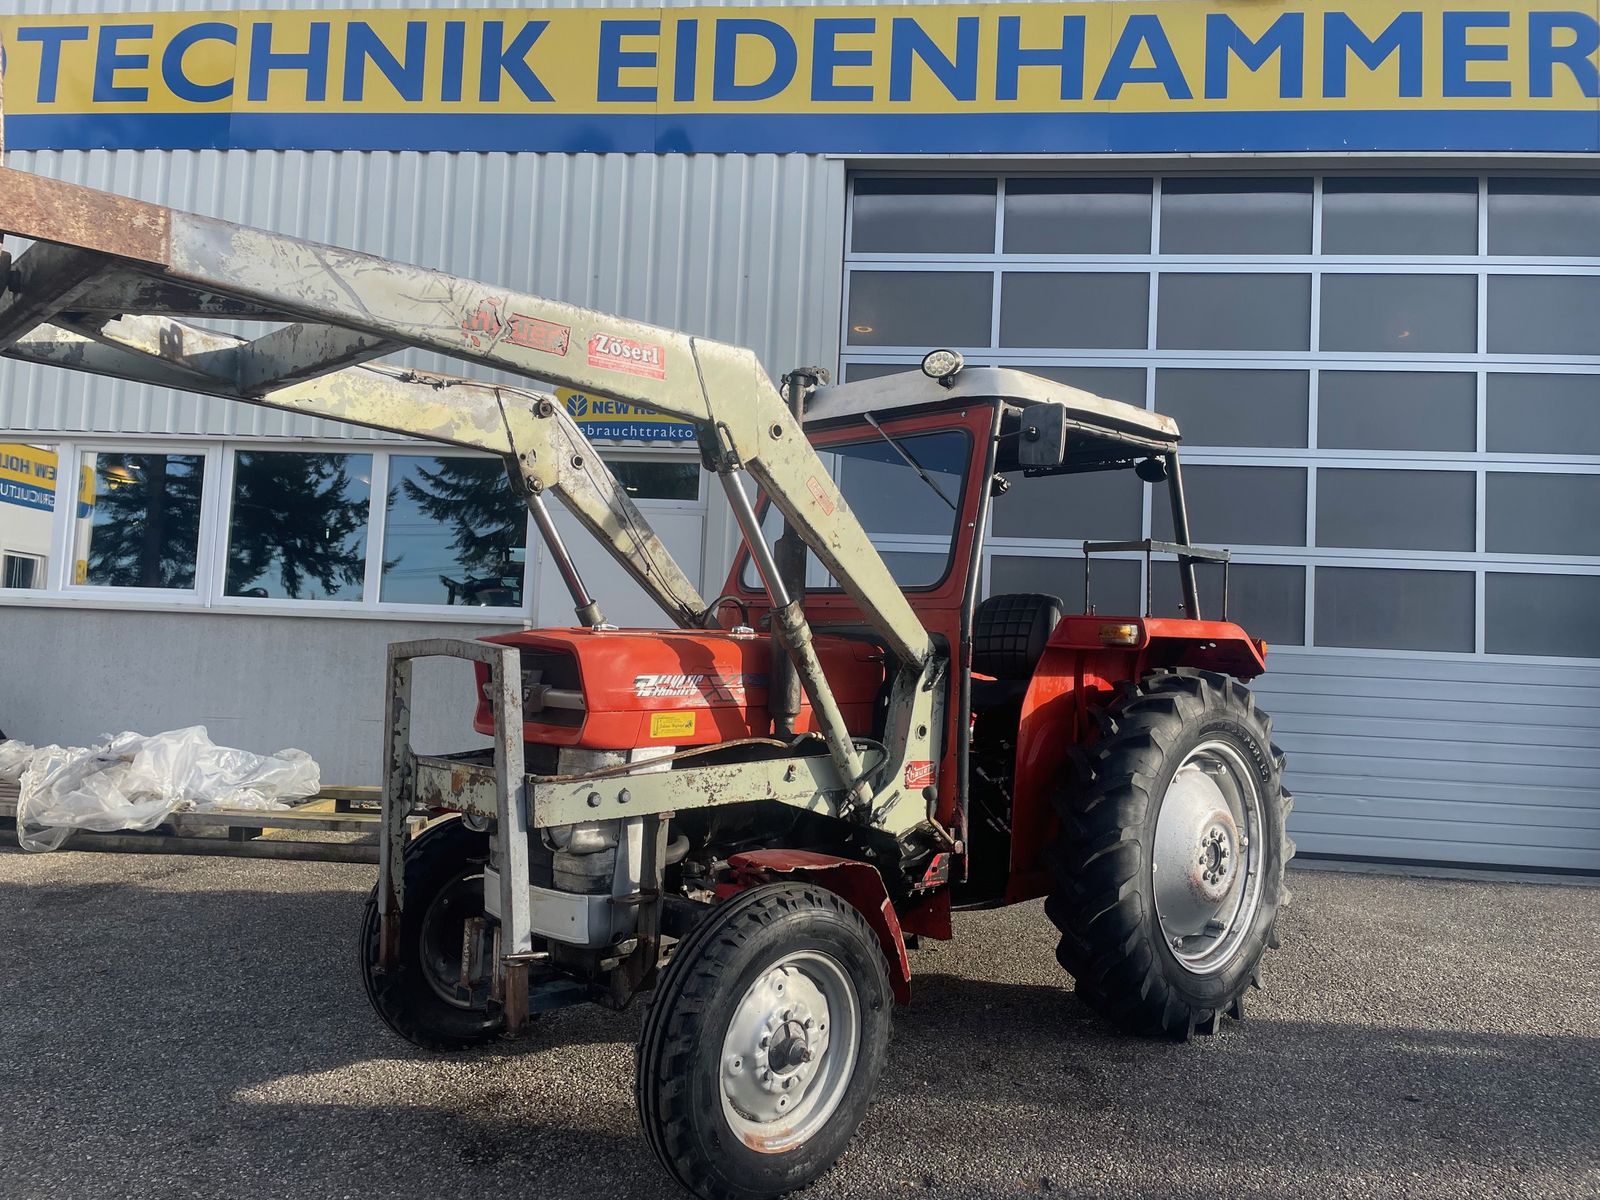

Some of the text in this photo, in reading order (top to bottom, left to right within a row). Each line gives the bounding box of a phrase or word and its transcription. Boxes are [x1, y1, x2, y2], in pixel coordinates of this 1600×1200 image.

[17, 10, 1600, 104] TECHNIK EIDENHAMMER
[594, 333, 660, 365] Zöserl
[592, 400, 631, 415] NEW
